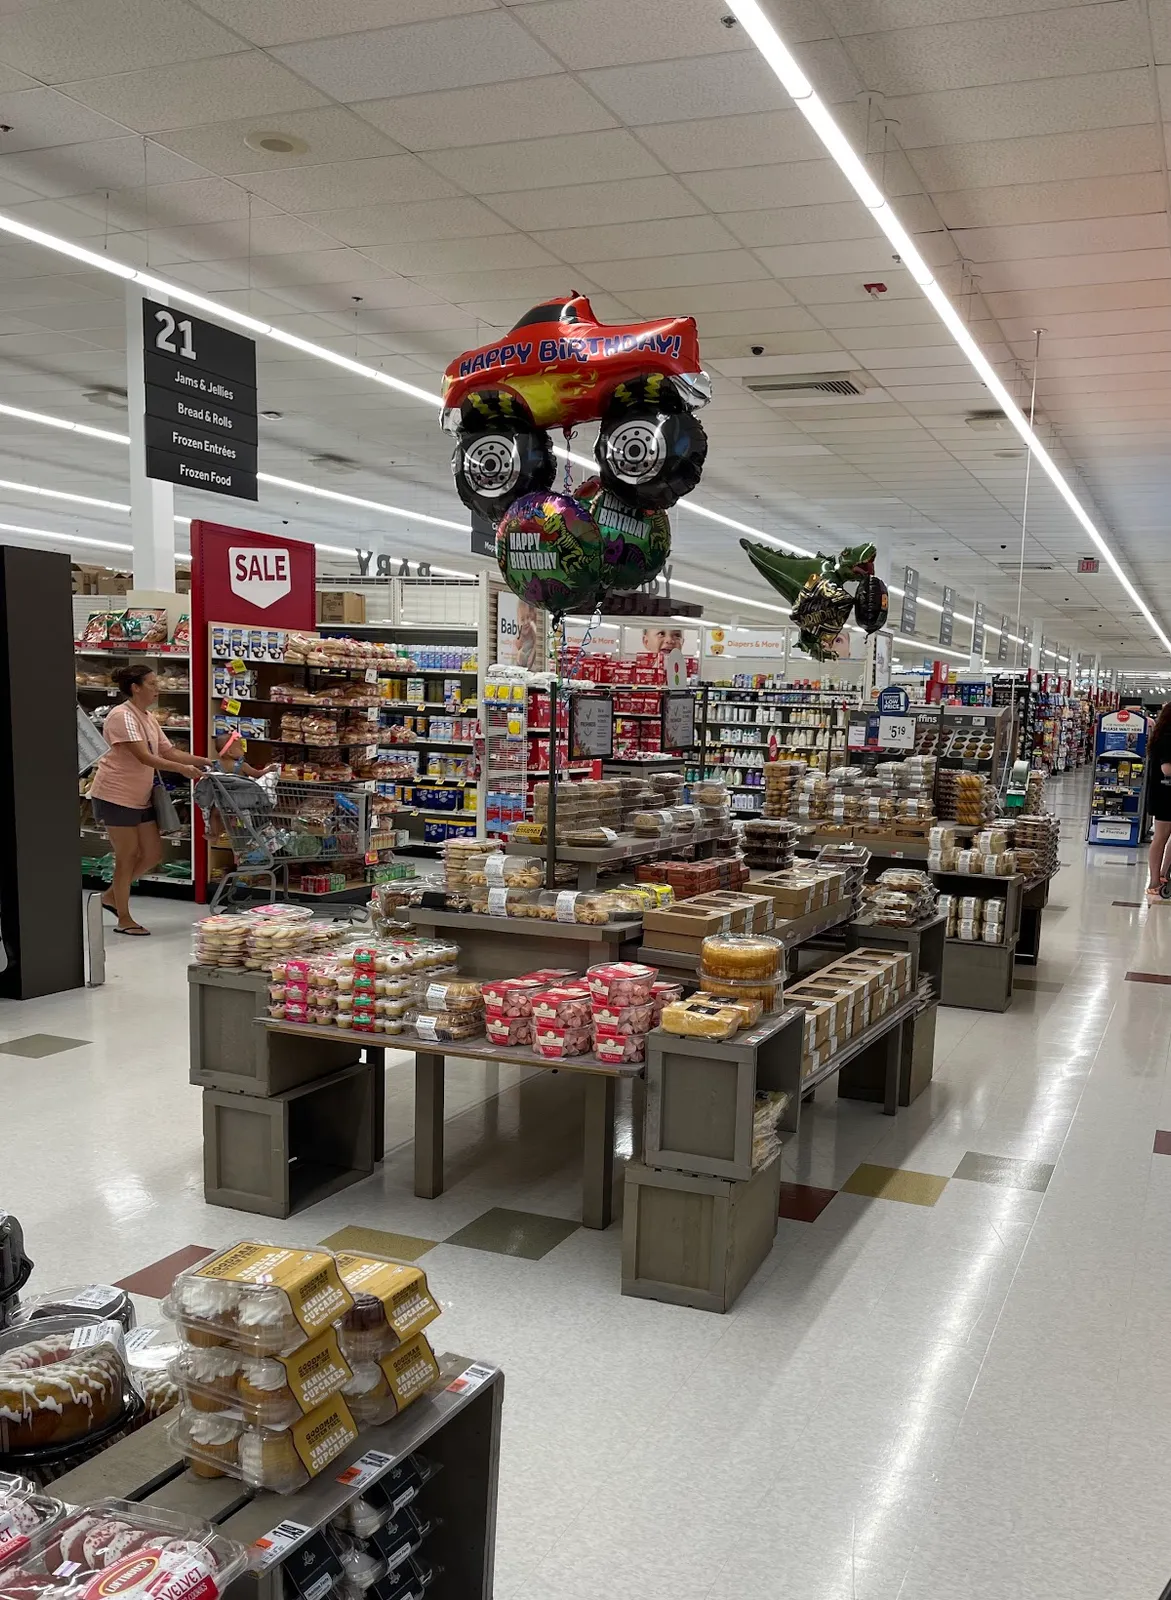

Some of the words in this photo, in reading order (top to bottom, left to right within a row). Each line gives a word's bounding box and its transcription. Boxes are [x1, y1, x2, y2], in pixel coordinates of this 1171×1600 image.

[154, 310, 197, 360] 21
[459, 342, 533, 378] HAPPY
[174, 371, 198, 388] Jams
[199, 379, 206, 391] &
[207, 382, 234, 400] Jellies
[177, 402, 203, 420] Bread
[204, 410, 212, 423] &
[212, 412, 233, 429] Rolls
[172, 431, 203, 450] Frozen
[203, 440, 237, 459] Entrées
[179, 463, 210, 482] Frozen
[210, 471, 232, 487] Food
[598, 507, 652, 540] BIRTHDAY
[484, 541, 498, 553] Mop
[509, 532, 541, 551] HAPPY
[235, 554, 287, 582] SALE
[509, 552, 557, 570] BIRTHDAY
[501, 617, 522, 640] Baby
[727, 640, 754, 649] Diapers
[300, 1285, 335, 1313] VANILLA
[303, 1288, 344, 1323] CUPCAKES
[393, 1297, 430, 1327] CUPCAKES
[300, 1363, 336, 1391] VANILLA
[302, 1367, 346, 1402] CUPCAKES
[395, 1359, 426, 1386] VANILLA
[397, 1363, 434, 1395] CUPCAKES
[305, 1412, 339, 1441] GOODMAN
[309, 1427, 347, 1459] VANILLA
[311, 1430, 355, 1470] CUPCAKES
[105, 1560, 152, 1593] LOFTHOUSE
[162, 1566, 203, 1599] VELVET
